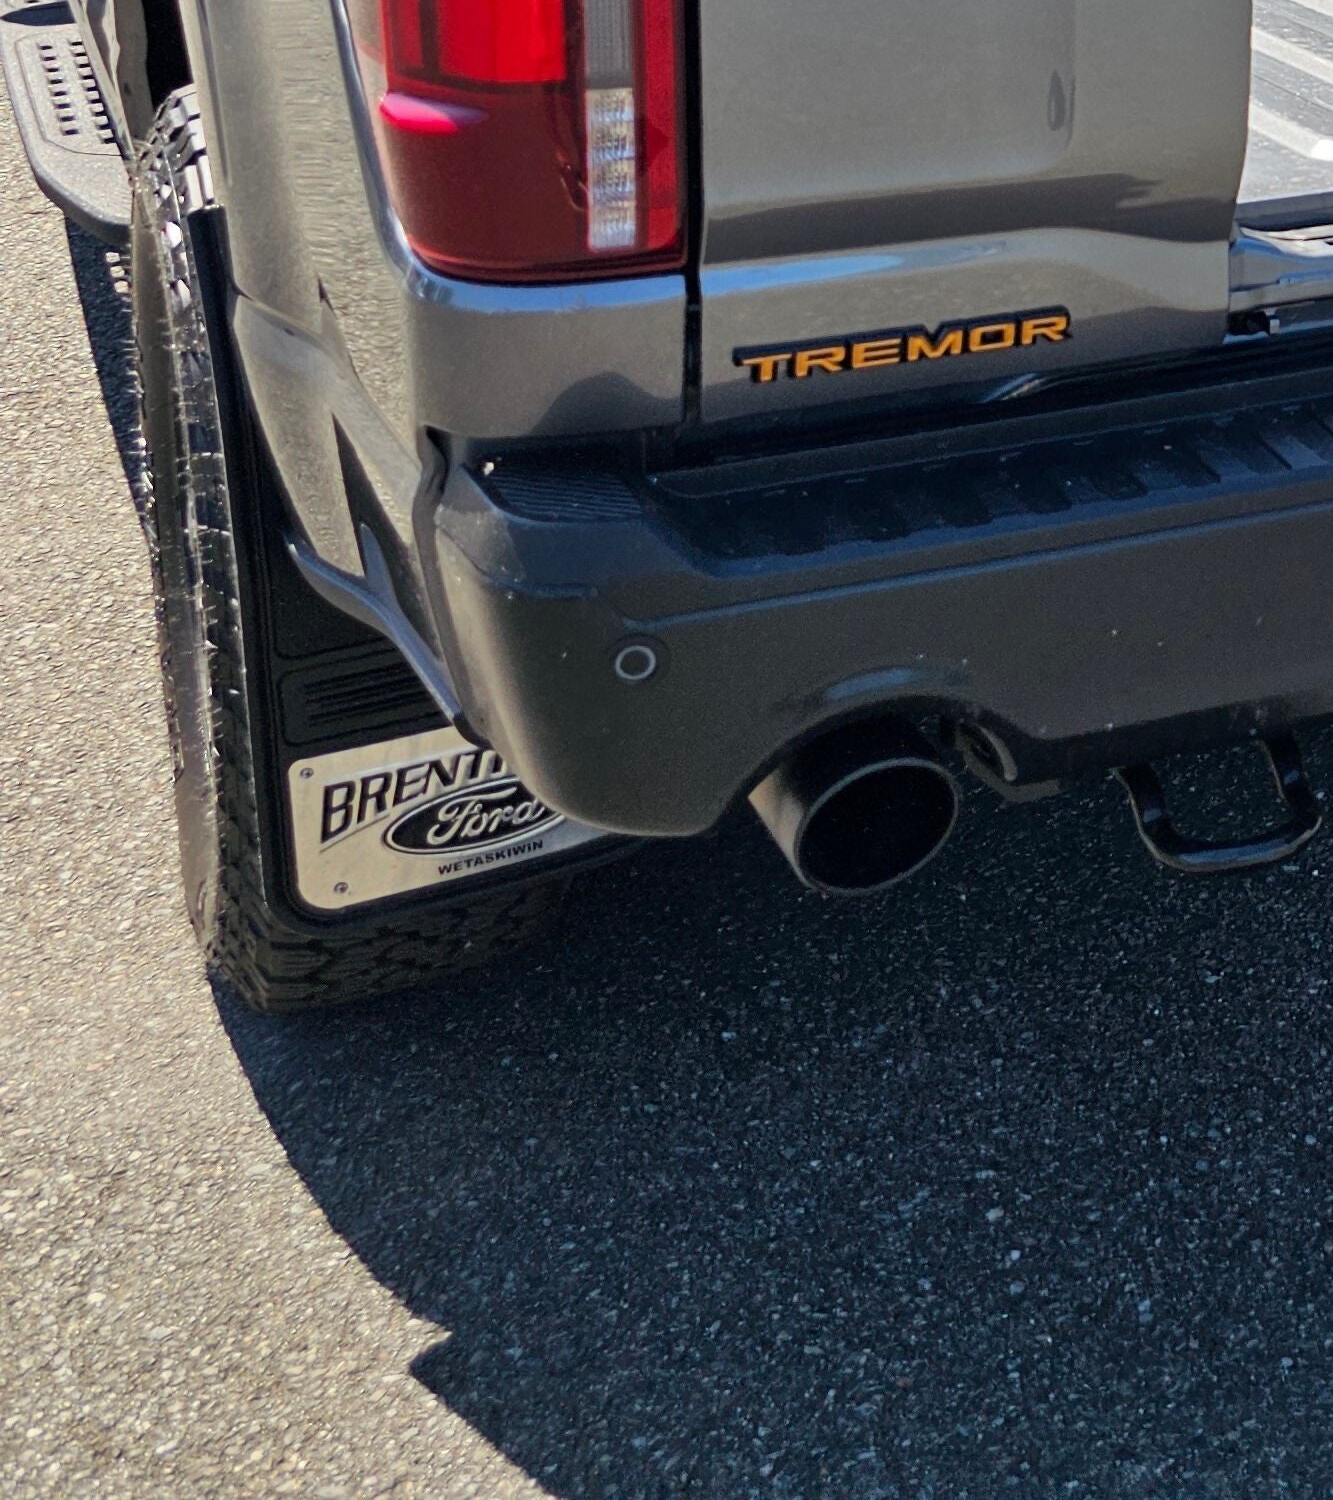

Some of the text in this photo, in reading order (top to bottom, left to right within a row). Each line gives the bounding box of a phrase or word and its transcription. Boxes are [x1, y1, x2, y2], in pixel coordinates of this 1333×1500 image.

[736, 308, 1071, 383] TREMOR
[426, 787, 546, 845] Ford
[438, 839, 544, 876] WETASKIWIN
